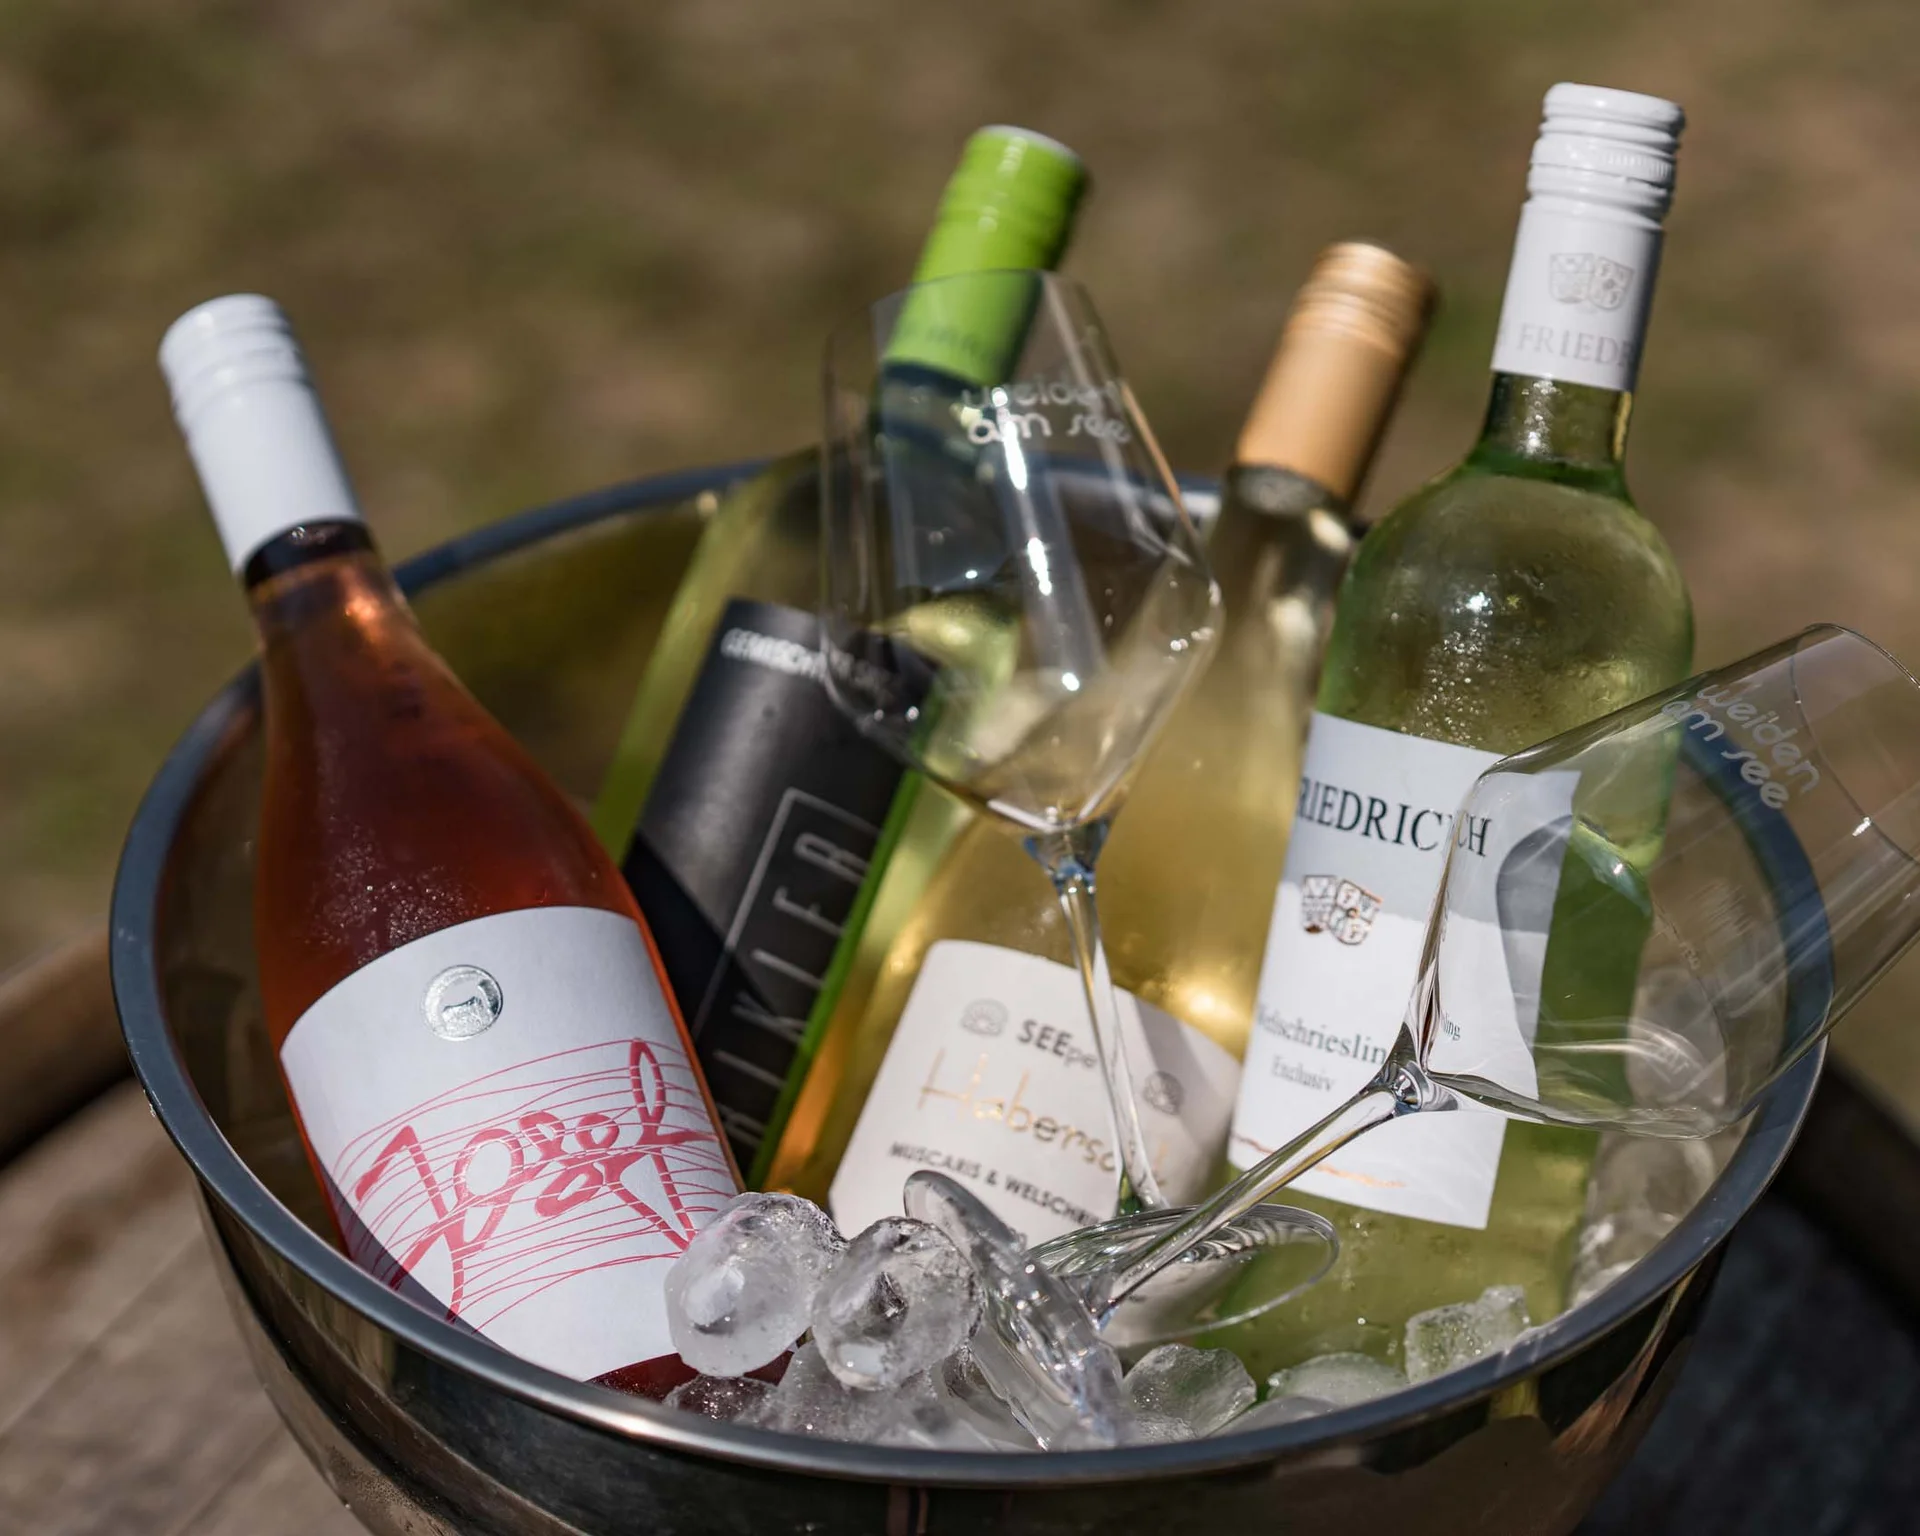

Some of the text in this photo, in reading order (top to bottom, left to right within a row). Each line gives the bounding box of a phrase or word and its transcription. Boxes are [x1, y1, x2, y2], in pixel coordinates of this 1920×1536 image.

[1662, 700, 1790, 809] am see
[1696, 684, 1820, 793] weiden
[987, 1171, 999, 1186] &
